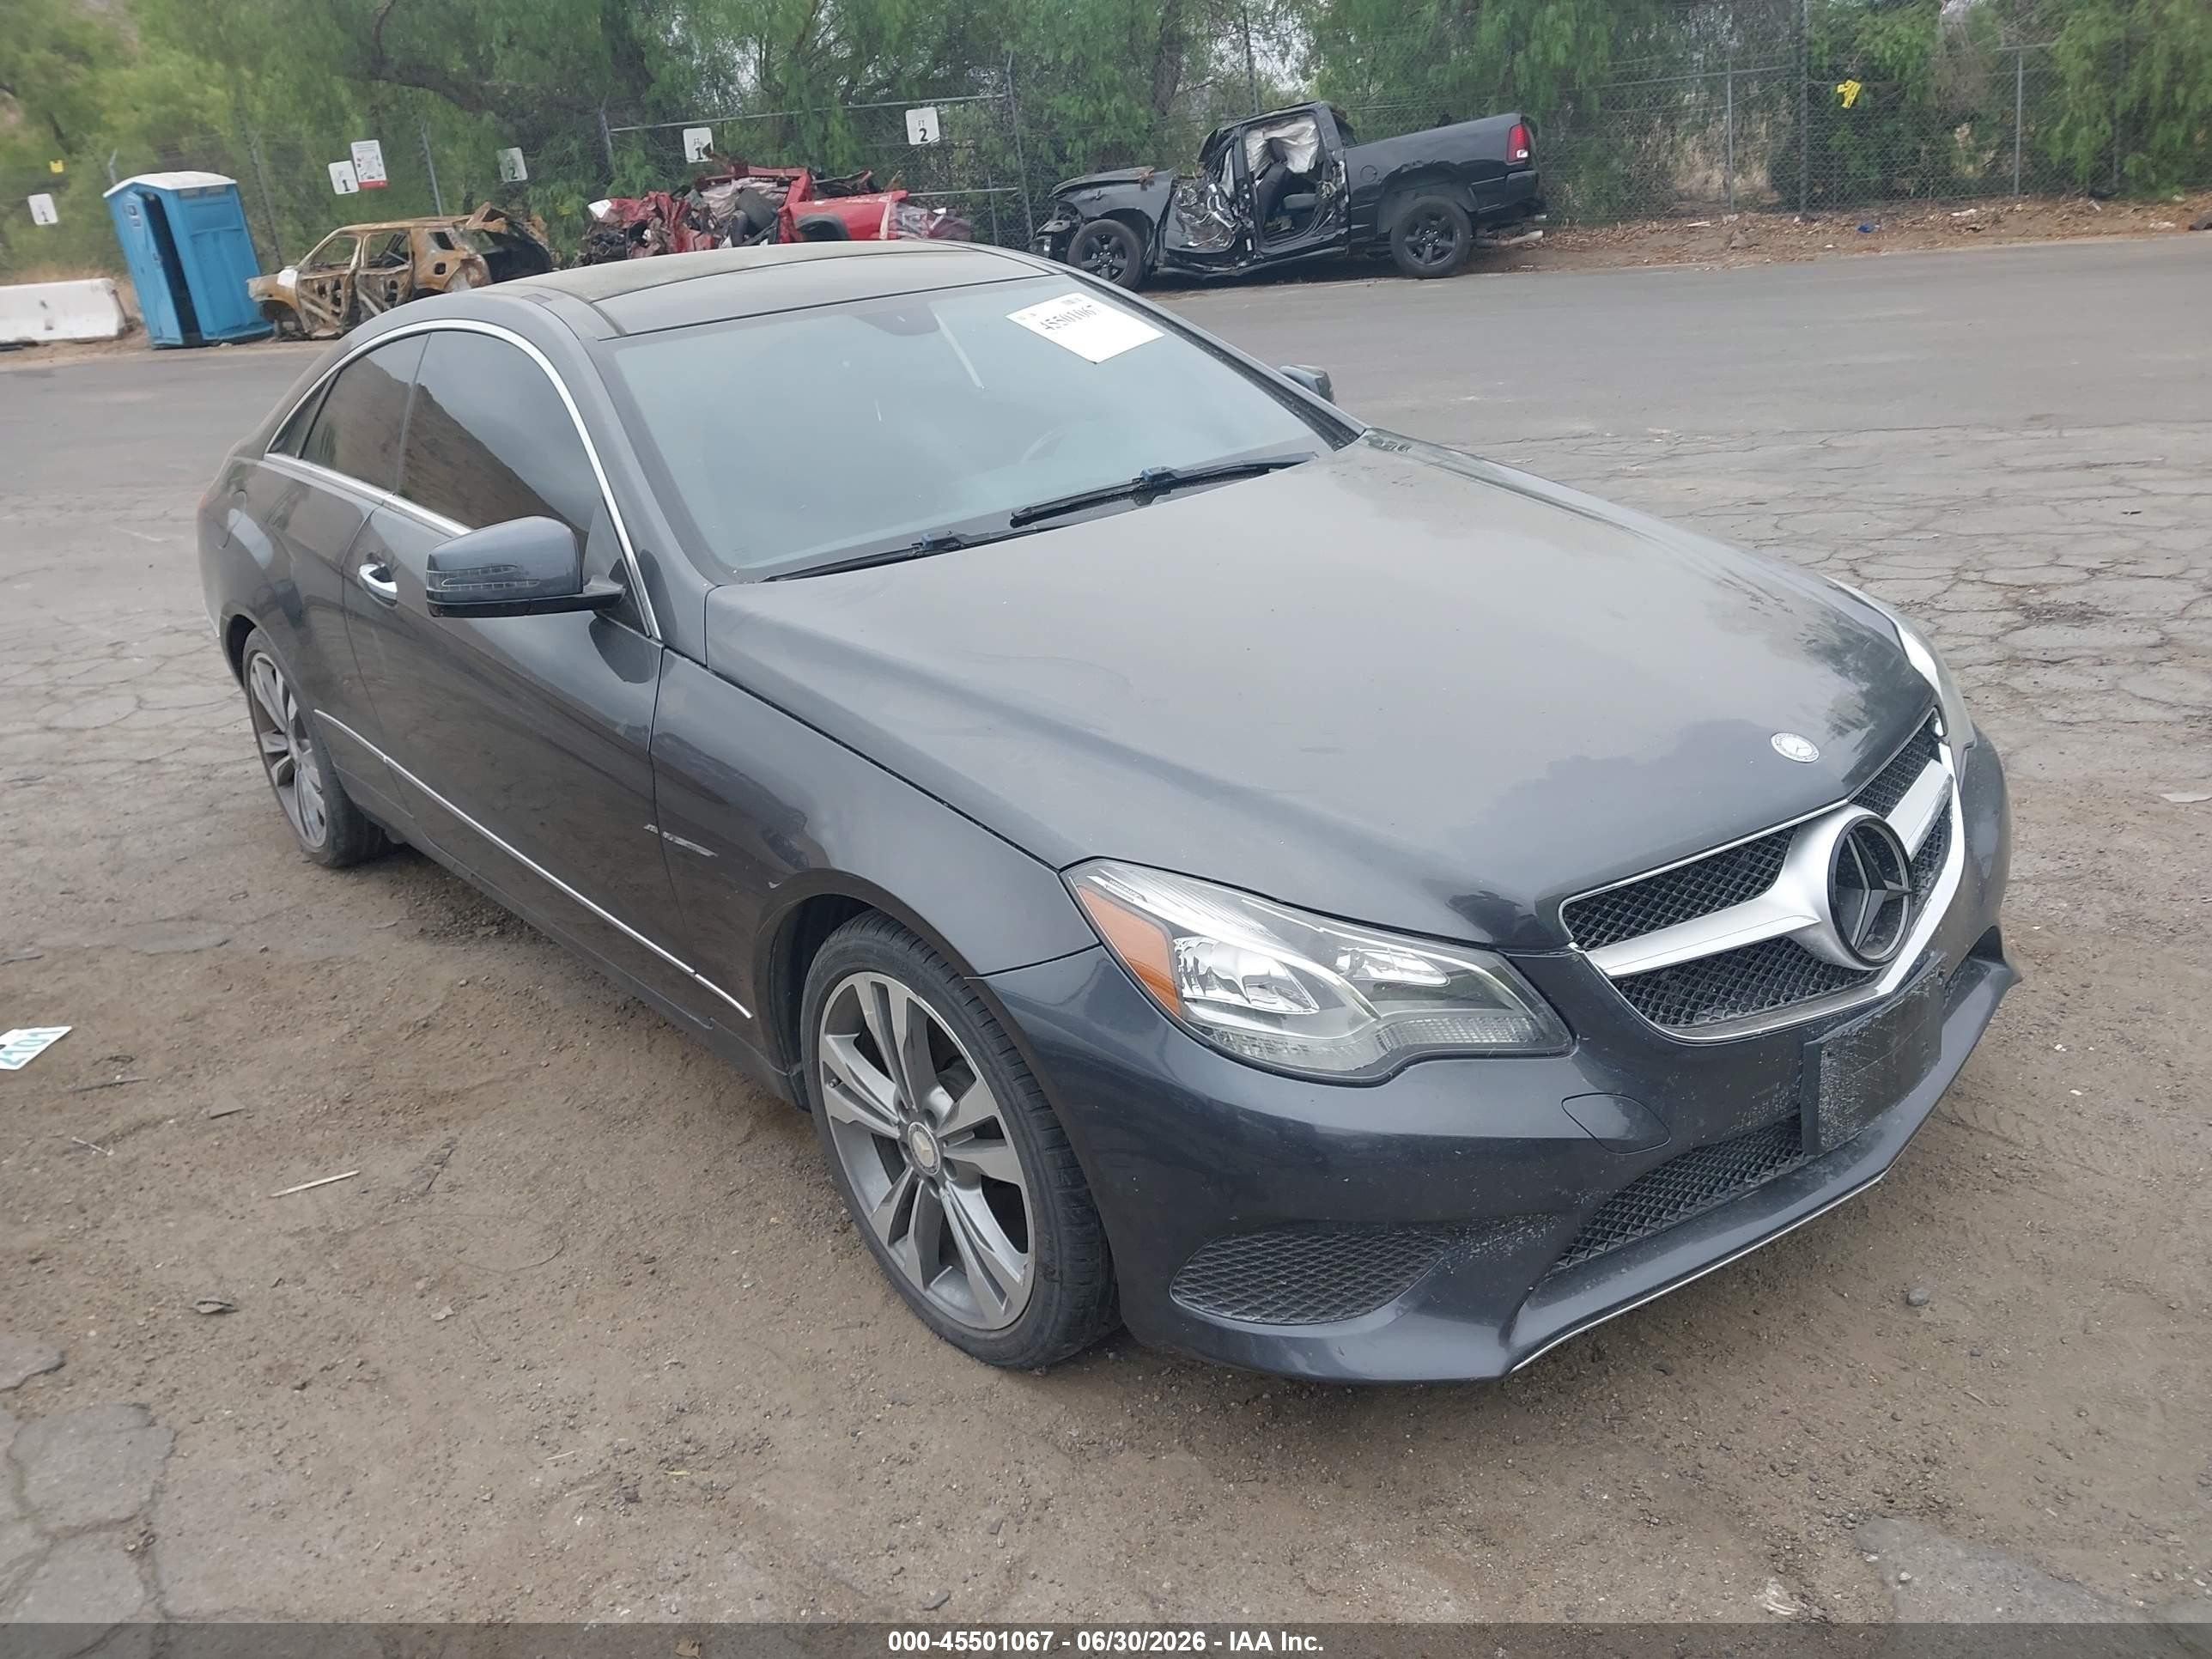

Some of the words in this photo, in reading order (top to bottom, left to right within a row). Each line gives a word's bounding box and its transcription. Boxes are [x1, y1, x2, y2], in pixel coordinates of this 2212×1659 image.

[919, 128, 928, 143] 2
[695, 147, 703, 160] 1
[508, 167, 518, 179] 2
[342, 179, 350, 191] 1
